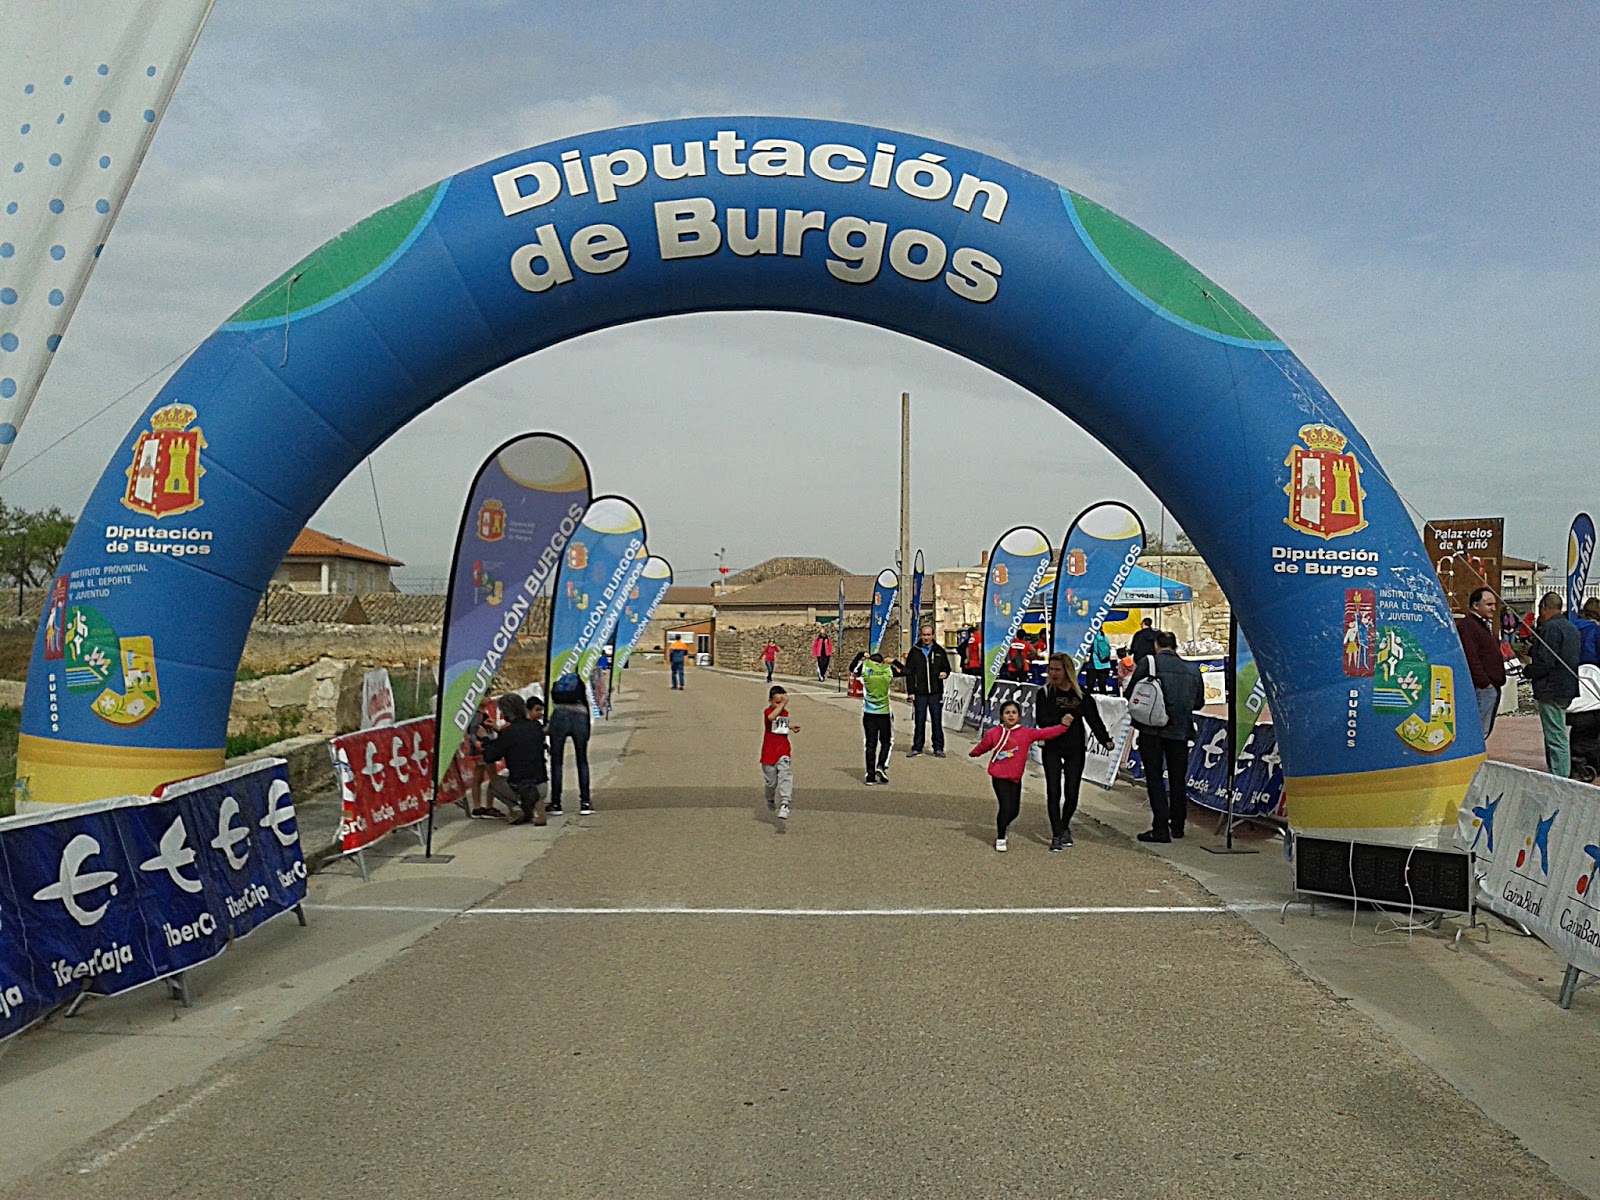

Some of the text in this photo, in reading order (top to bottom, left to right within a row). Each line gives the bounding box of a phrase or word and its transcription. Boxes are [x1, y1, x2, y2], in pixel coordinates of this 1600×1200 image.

[492, 131, 1009, 223] Diputación
[510, 197, 1002, 303] de Burgos
[106, 525, 213, 541] Diputación
[1434, 527, 1494, 540] Palazelos
[106, 540, 211, 557] de Burgos
[1439, 539, 1453, 550] de
[1271, 546, 1379, 562] Diputación
[104, 563, 148, 574] PROVINCIAL
[1273, 561, 1379, 578] de Burgos
[87, 579, 95, 587] EL
[99, 576, 132, 586] DEPORTE
[75, 588, 110, 600] JUVENTUD
[559, 538, 641, 680] IPUTACIÓN BURGOS
[1074, 606, 1108, 670] UTACIÓN
[1103, 544, 1141, 607] BURGOS
[1380, 601, 1399, 610] PARA
[1402, 602, 1410, 610] EL
[453, 594, 530, 731] DIPUTACIÓN
[524, 503, 584, 597] BURGOS
[582, 562, 645, 678] DIPUTACIÓN BURGOS
[990, 558, 1049, 675] DIPUTACIÓN BURGOS
[1380, 612, 1423, 622] Y JUVENTUD
[49, 673, 59, 732] BURGOS
[1347, 689, 1358, 748] BURGOS
[51, 942, 133, 987] iberCaja
